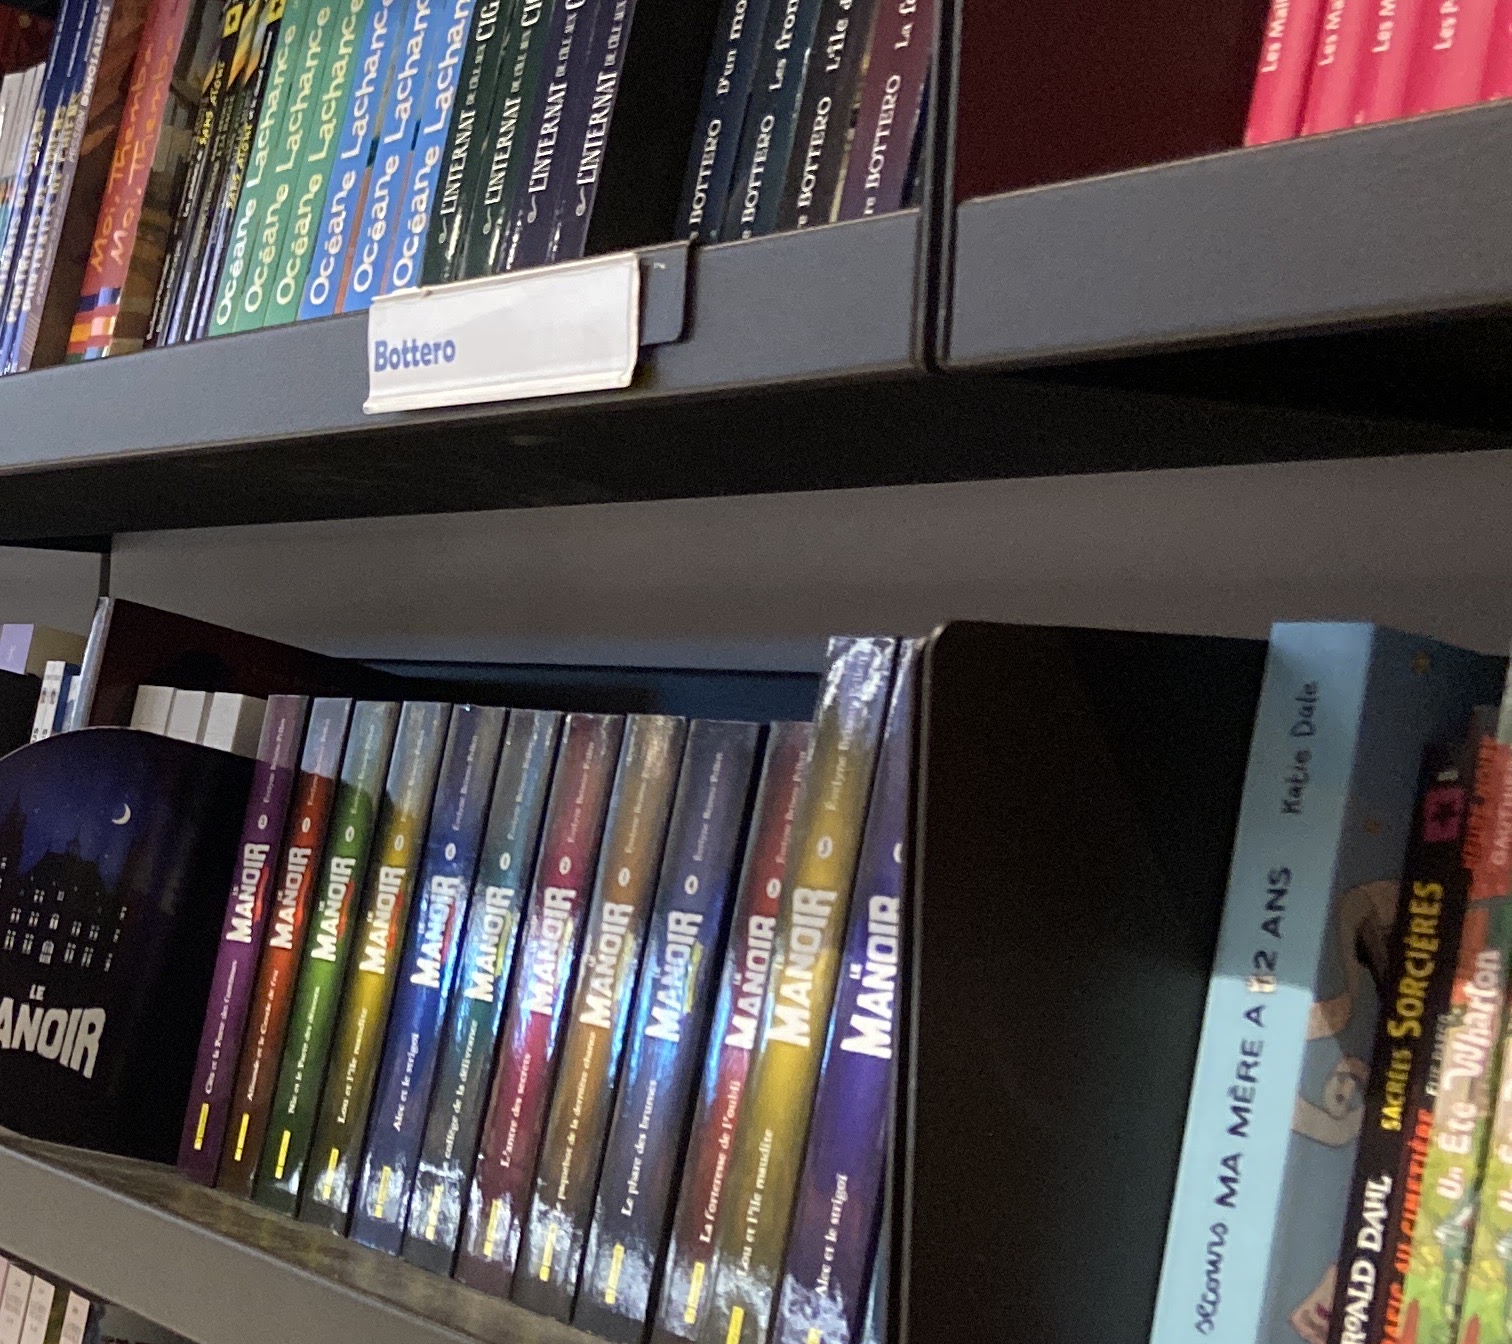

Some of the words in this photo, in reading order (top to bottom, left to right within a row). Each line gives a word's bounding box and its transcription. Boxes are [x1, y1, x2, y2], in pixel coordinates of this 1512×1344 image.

[1261, 43, 1282, 73] Les
[1318, 34, 1338, 66] Les
[1372, 21, 1394, 53] Les
[1433, 17, 1457, 50] Les
[484, 96, 521, 205] L'INTERNAT
[528, 82, 567, 193] L'INTERNAT
[576, 71, 618, 184] L'INTERNAT
[689, 119, 721, 225] BOTTERO
[717, 48, 737, 96] D'un
[741, 115, 775, 224] BOTTERO
[769, 57, 787, 92] Les
[797, 96, 832, 208] BOTTERO
[865, 74, 901, 189] BOTTERO
[894, 22, 914, 51] La
[216, 199, 256, 325] Océane
[246, 24, 297, 188] Lachance
[245, 184, 288, 312] Océane
[276, 6, 331, 173] Lachance
[440, 110, 476, 215] L'INTERNAT
[276, 173, 323, 305] Océane
[310, 170, 356, 305] Océane
[353, 154, 400, 292] Océane
[393, 145, 440, 288] Océane
[374, 338, 455, 373] Bottero
[1291, 680, 1318, 737] Dale
[1280, 750, 1312, 815] Katie
[226, 843, 270, 944] MANOIR
[270, 846, 312, 949] MANOIR
[311, 856, 356, 962] MANOIR
[359, 866, 406, 974] MANOIR
[410, 875, 460, 989] MANOIR
[464, 886, 515, 1003] MANOIR
[1262, 867, 1292, 938] ANS
[29, 984, 46, 1001] LE
[530, 887, 577, 1016] MANOIR
[579, 902, 635, 1029] MANOIR
[645, 911, 704, 1042] MANOIR
[724, 915, 776, 1049] MANOIR
[767, 888, 837, 1047] MANOIR
[841, 895, 900, 1059] MANOIR
[1388, 880, 1444, 1039] SORCIÈRES
[1244, 1005, 1266, 1028] A
[1449, 948, 1502, 1081] Wharton
[639, 1080, 657, 1130] brumes
[718, 1131, 730, 1149] de
[722, 1080, 740, 1130] l'oubli
[1227, 1040, 1265, 1138] MÈRE
[627, 1157, 641, 1195] phare
[634, 1133, 645, 1154] des
[704, 1152, 726, 1222] forteresse
[1214, 1152, 1242, 1208] MA
[1437, 1162, 1467, 1201] Un
[621, 1197, 634, 1216] Le
[699, 1222, 713, 1244] La
[1356, 1174, 1393, 1253] DAHL
[1195, 1222, 1228, 1335] secours
